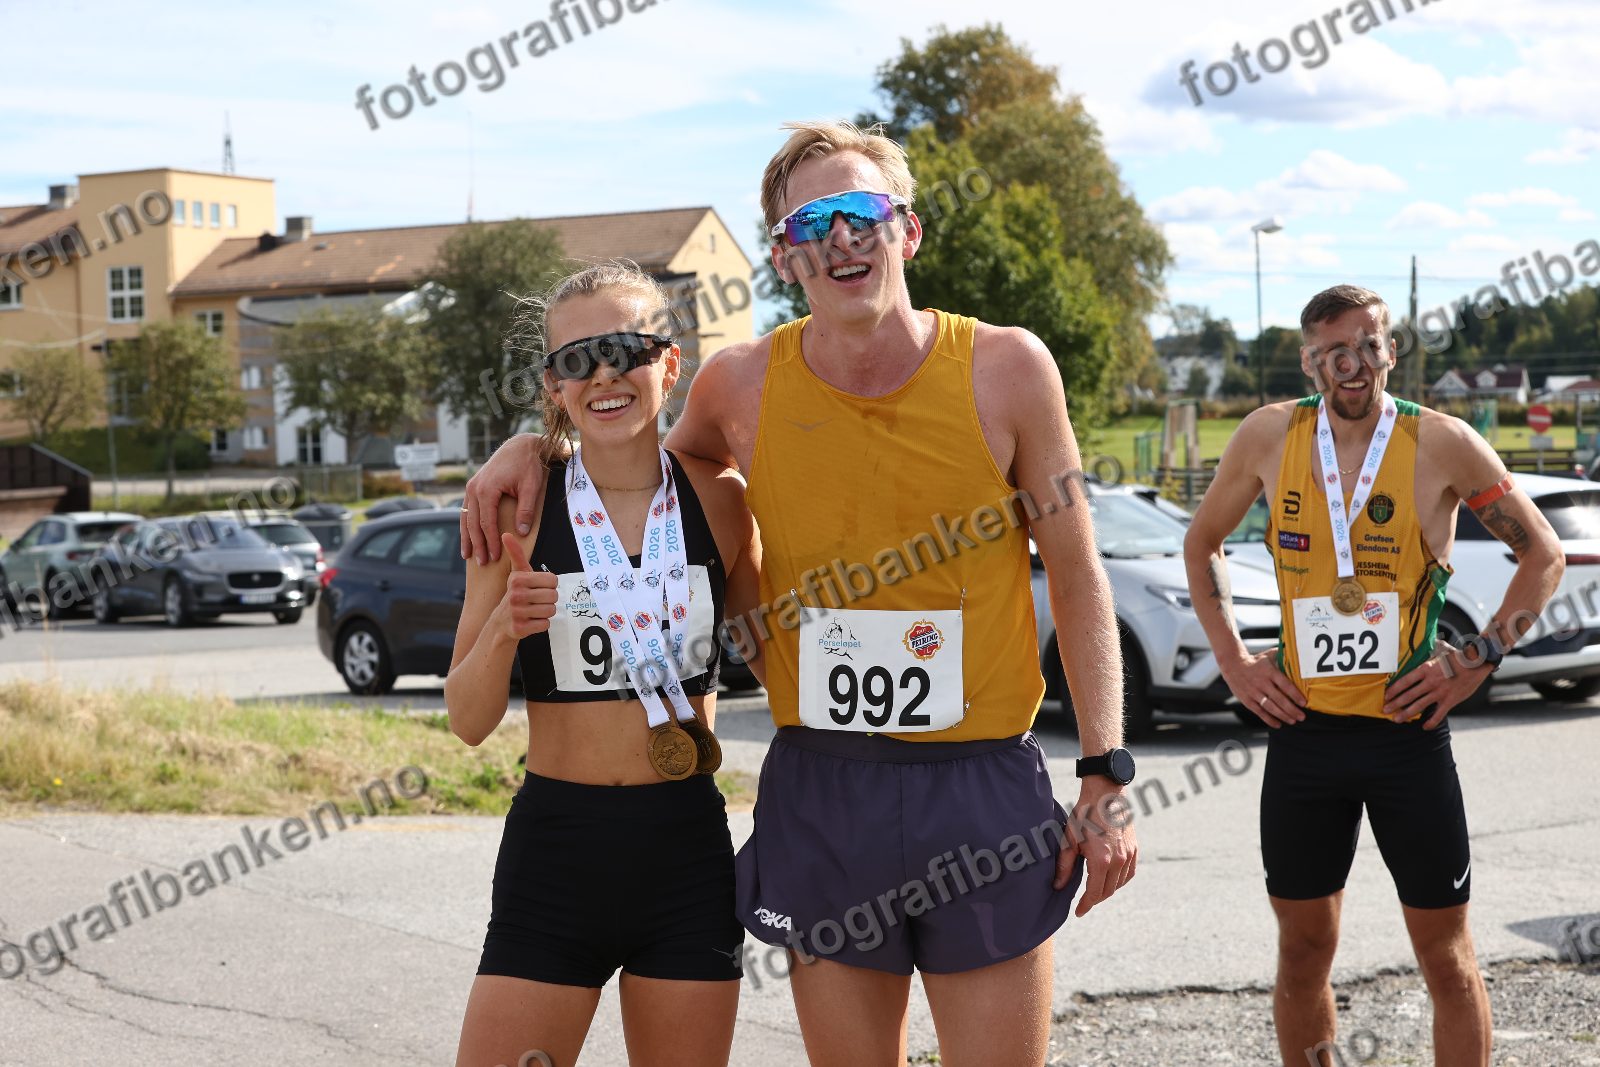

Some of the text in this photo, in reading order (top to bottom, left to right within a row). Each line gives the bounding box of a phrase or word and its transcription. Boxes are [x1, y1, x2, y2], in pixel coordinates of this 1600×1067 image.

[1322, 444, 1333, 466] 2026
[1367, 446, 1381, 469] 2026
[582, 535, 600, 567] 2026
[600, 534, 623, 566] 2026
[647, 527, 661, 560] 2026
[664, 519, 680, 552] 2026
[1356, 543, 1401, 554] Eiendom AS
[1364, 533, 1394, 543] Grefsen
[1356, 561, 1390, 570] JESSHEIM
[620, 640, 641, 673] 2026
[647, 638, 669, 671] 2026
[818, 638, 862, 649] Perseløpet
[911, 632, 939, 649] FEIRING
[1314, 629, 1380, 673] 252
[828, 663, 931, 728] 992
